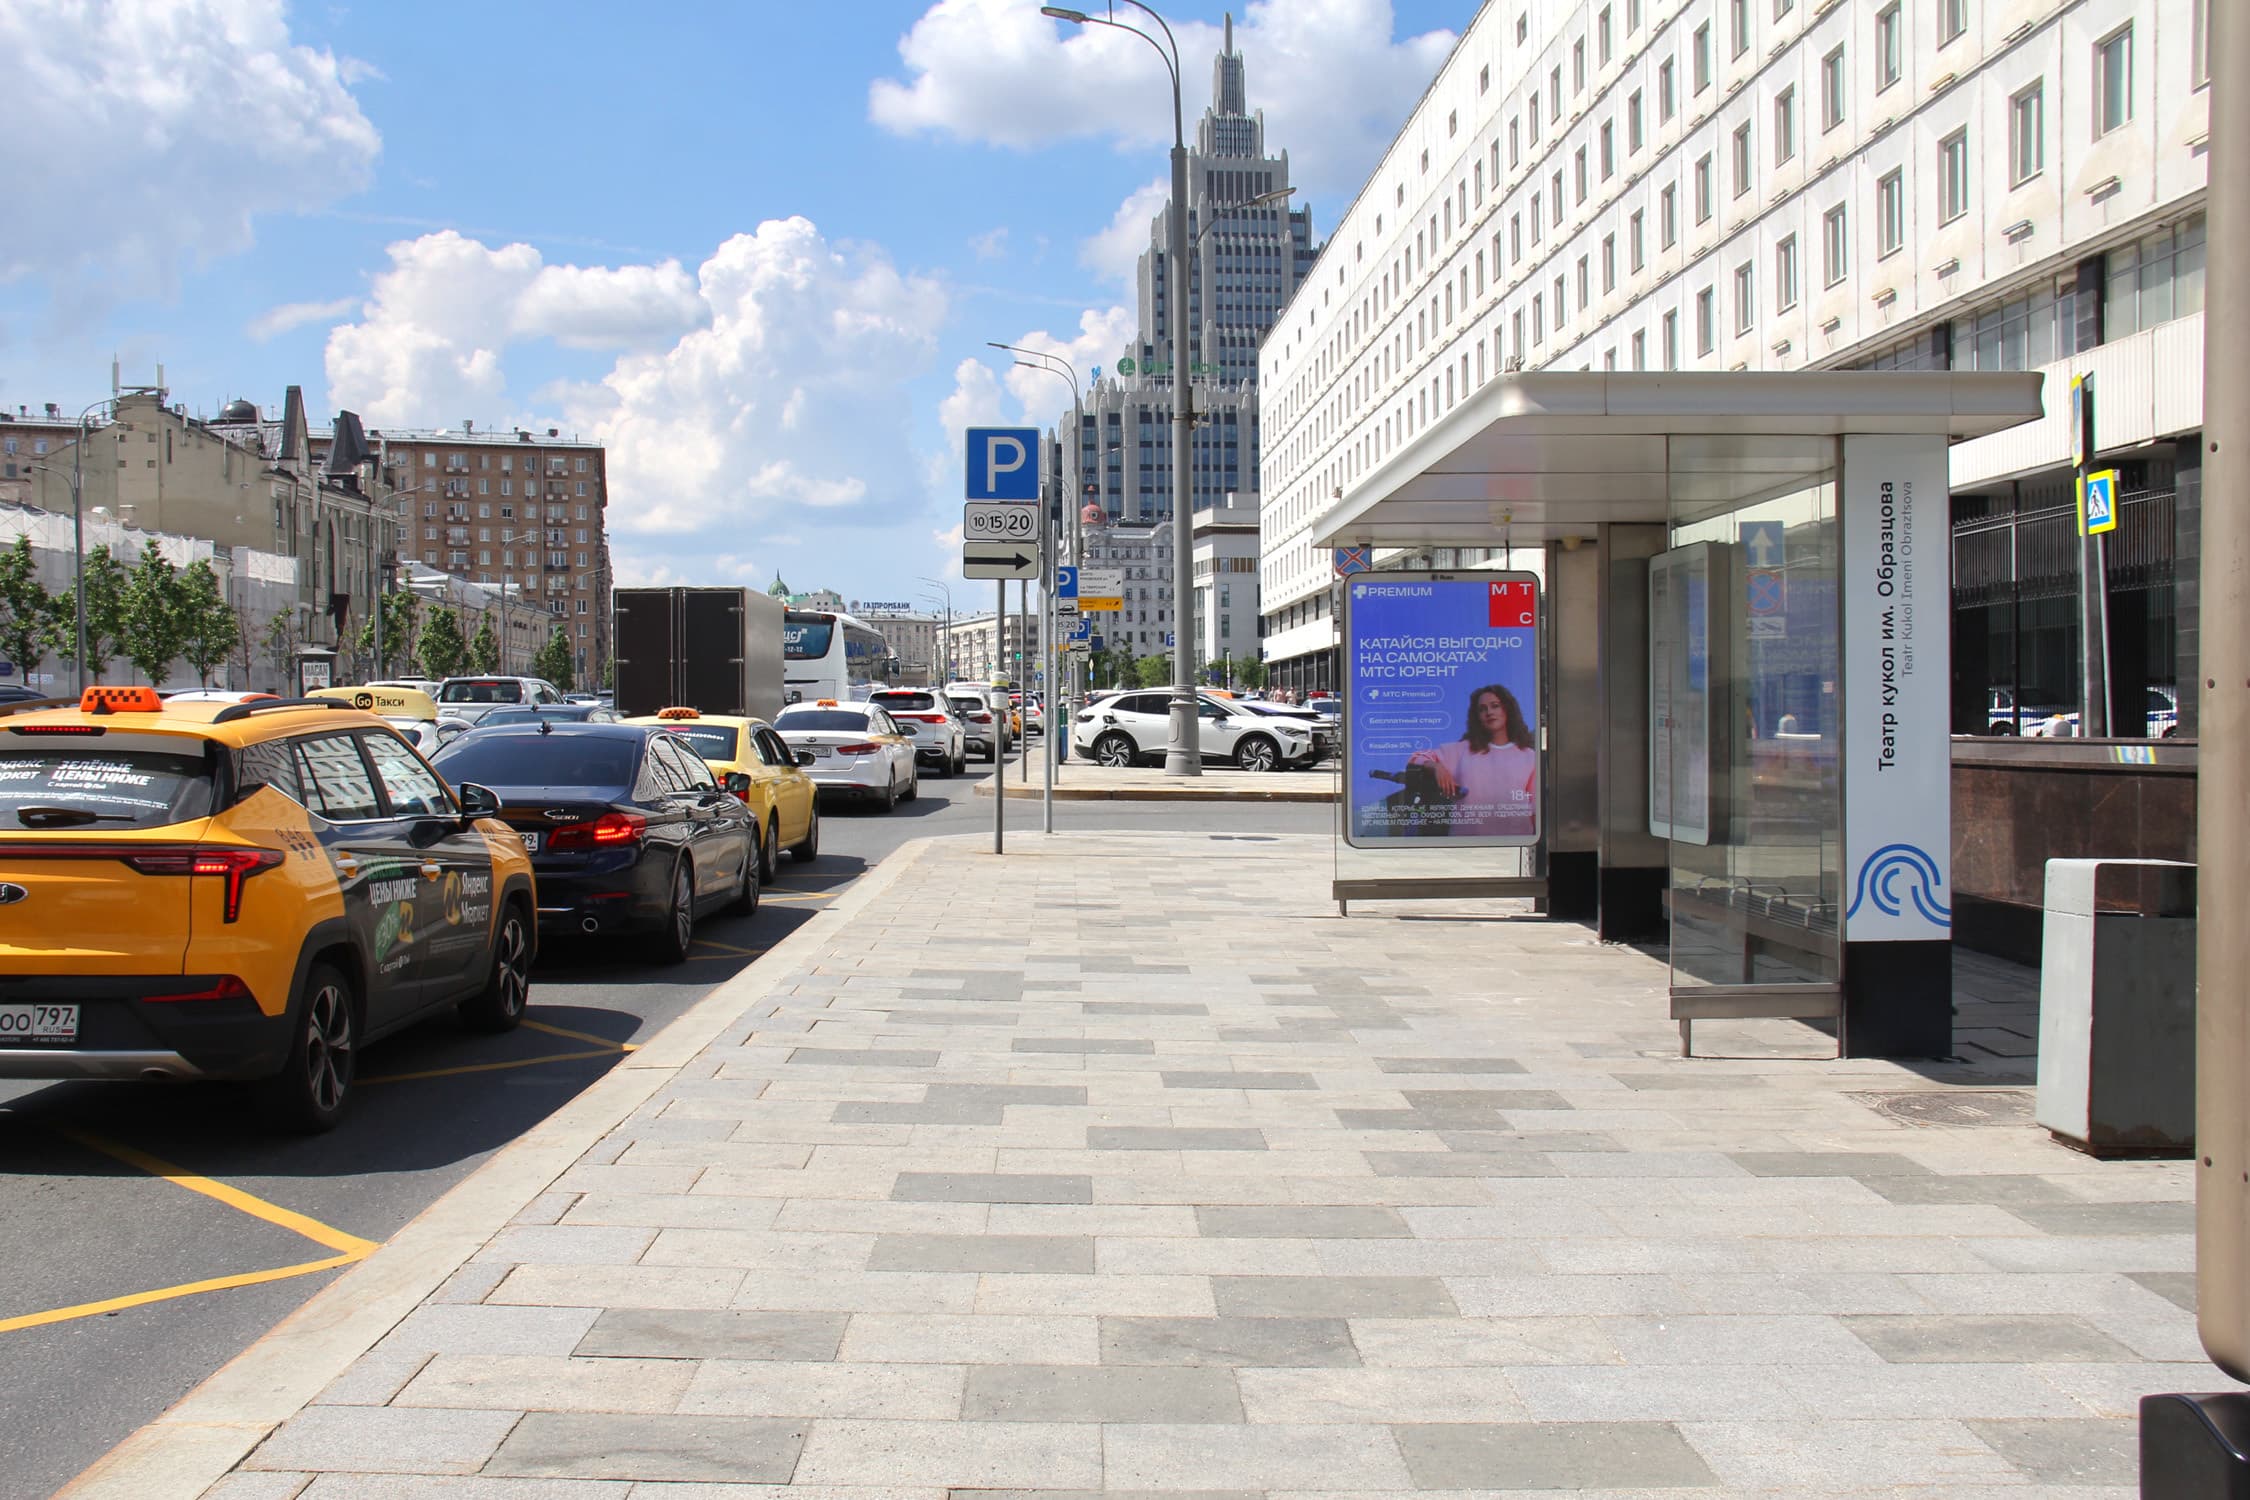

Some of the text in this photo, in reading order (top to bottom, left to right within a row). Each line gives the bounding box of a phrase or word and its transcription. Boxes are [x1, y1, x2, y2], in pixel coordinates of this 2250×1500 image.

[987, 436, 1026, 492] P
[974, 515, 1030, 530] 10 15 20
[1901, 481, 1913, 678] Teatr Kukol Imeni Obraztsova
[1368, 587, 1432, 597] PREMIUM
[863, 602, 911, 610] ГАЗПРОМБАНК
[1877, 481, 1898, 771] Театр кукол им. Образцова
[1360, 635, 1523, 650] КАТАЙСЯ ВЫГОДНО
[1360, 651, 1488, 664] НА САМОКАТАХ
[1360, 665, 1459, 678] МТС ЮРЕНТ
[357, 694, 371, 707] Go
[376, 695, 405, 707] Такси
[1402, 690, 1436, 698] Premium
[58, 760, 134, 774] ЗЕЛЁНЫЕ
[52, 769, 102, 781] ЦЕНЫ
[1511, 790, 1533, 801] 18+
[463, 872, 488, 897] Яндекс
[369, 880, 393, 909] ЦЕНЫ
[462, 901, 489, 927] Маркет
[37, 1007, 73, 1025] 797
